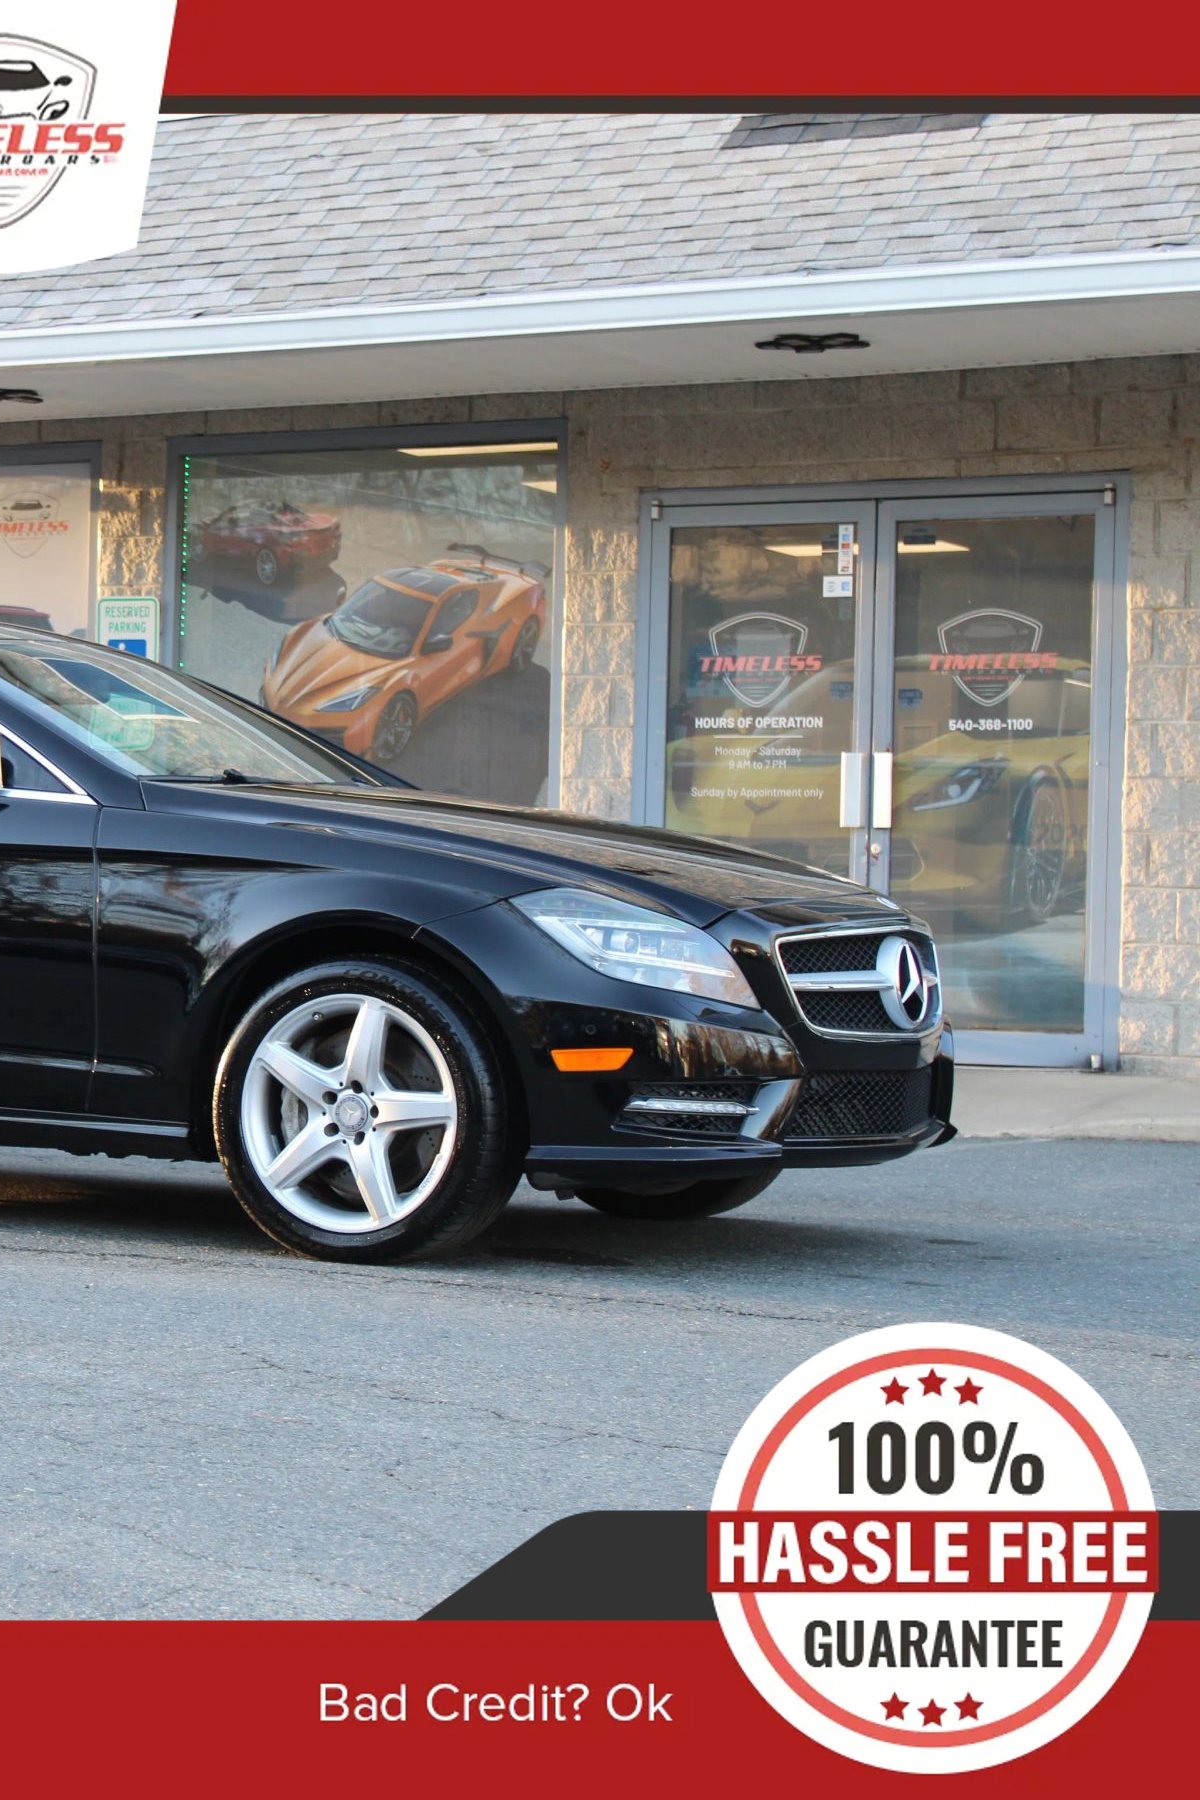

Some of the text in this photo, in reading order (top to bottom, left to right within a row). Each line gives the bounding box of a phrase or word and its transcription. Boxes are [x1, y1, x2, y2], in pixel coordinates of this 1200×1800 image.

[105, 606, 150, 618] RESERVED
[108, 622, 146, 633] PARKING
[699, 655, 822, 672] TIMELESS
[927, 652, 1059, 671] TIMELESS
[695, 716, 824, 729] HOURS OF OPERATION
[948, 719, 1033, 731] 540-368-1100
[714, 746, 752, 758] Monday
[759, 746, 802, 758] Saturday
[738, 760, 751, 769] AM
[753, 760, 763, 769] to
[765, 760, 770, 769] 7
[772, 760, 787, 769] PM
[691, 786, 824, 799] Sunday by Appointment only
